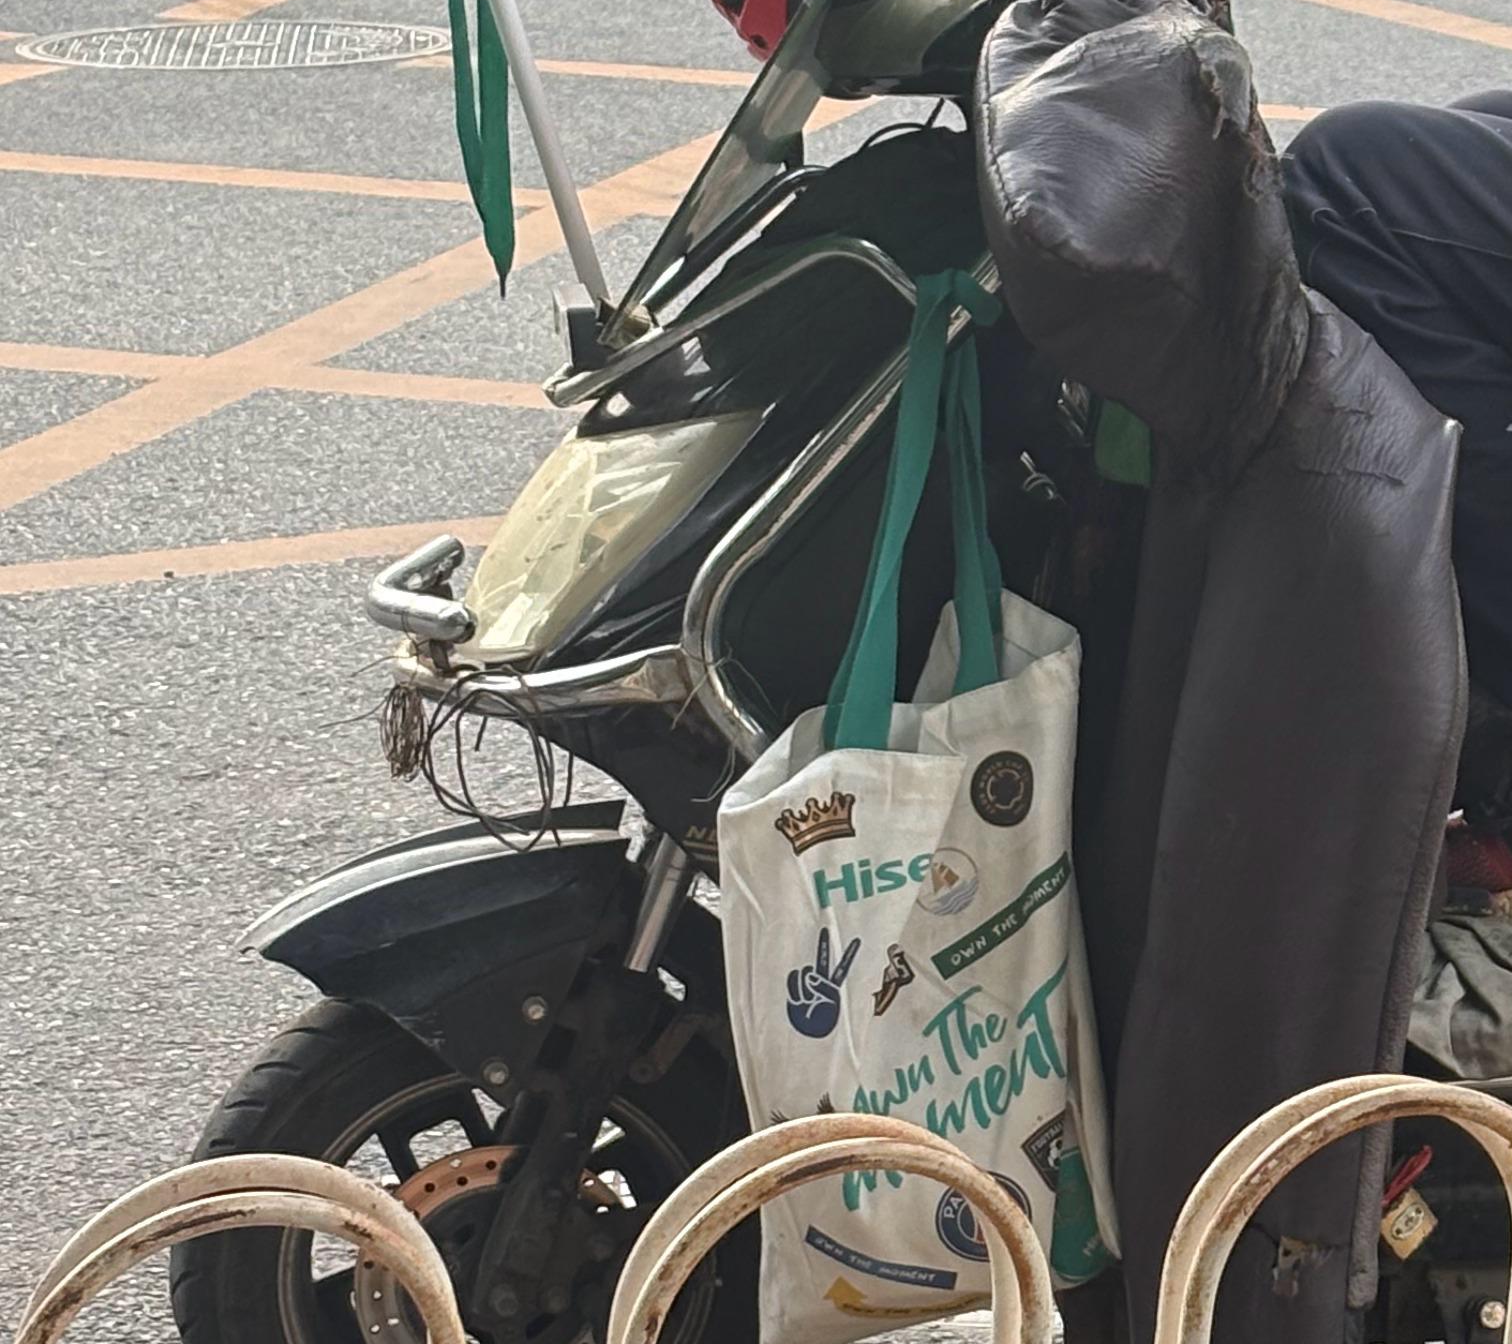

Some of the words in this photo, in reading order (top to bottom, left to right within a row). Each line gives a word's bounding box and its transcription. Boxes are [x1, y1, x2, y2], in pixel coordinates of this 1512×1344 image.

[951, 936, 987, 966] OWN
[992, 913, 1018, 936] THE
[922, 985, 1007, 1076] The
